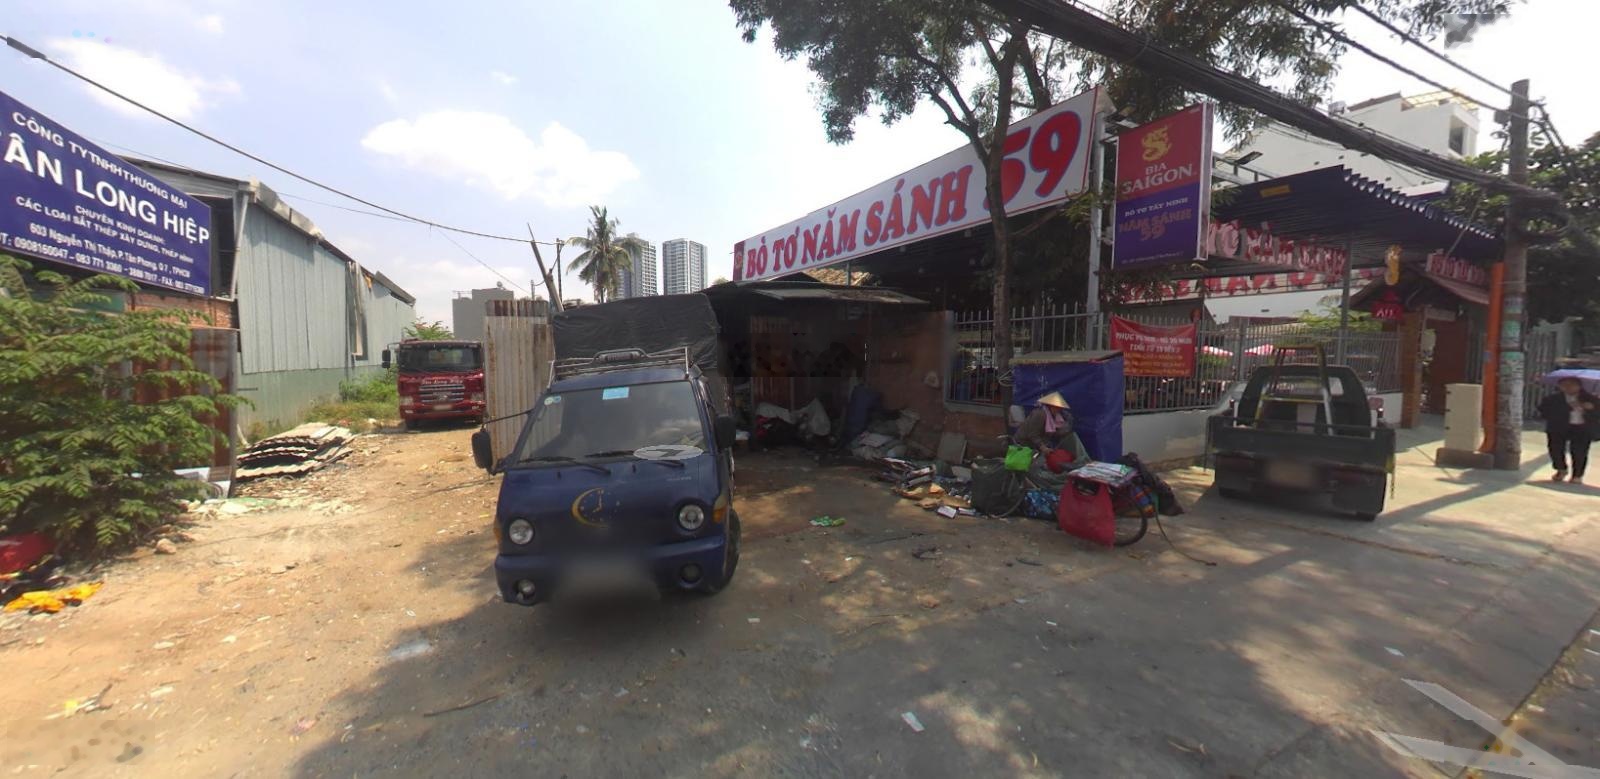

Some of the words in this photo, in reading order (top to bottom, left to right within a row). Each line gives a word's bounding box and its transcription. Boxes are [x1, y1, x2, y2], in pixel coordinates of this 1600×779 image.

[12, 111, 64, 147] CÔNG
[1121, 163, 1193, 194] SAIGON
[1144, 162, 1168, 175] BIA
[1, 132, 63, 185] ÂN
[75, 169, 157, 225] LONG
[163, 210, 209, 244] HIỆP
[16, 196, 42, 213] CÁC
[745, 236, 768, 280] BÒ
[773, 226, 800, 272] TƠ
[801, 207, 861, 265] NĂM
[863, 165, 973, 247] SÁNH
[983, 110, 1082, 211] 59
